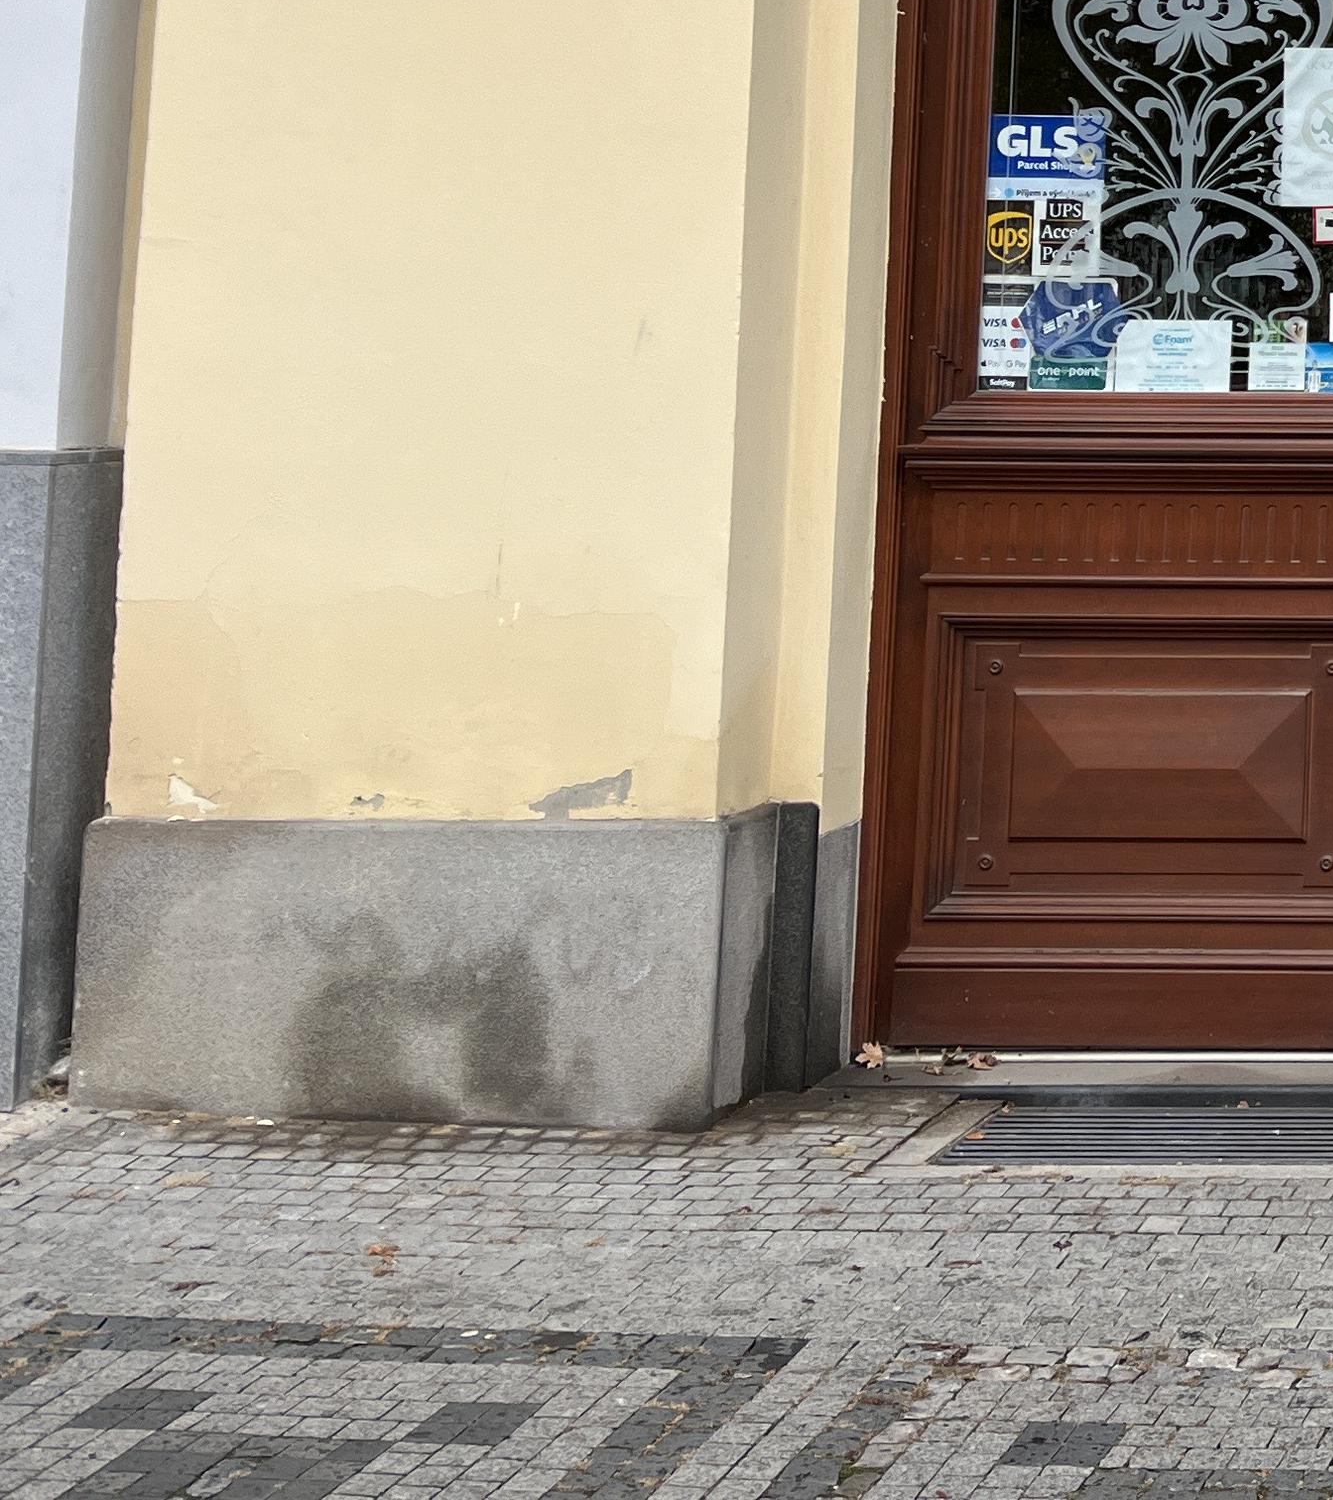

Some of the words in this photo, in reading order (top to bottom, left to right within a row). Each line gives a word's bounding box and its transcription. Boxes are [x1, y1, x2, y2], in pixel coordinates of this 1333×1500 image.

[997, 125, 1079, 158] GLS
[1018, 161, 1048, 170] Parcel
[1049, 203, 1081, 217] UPS
[991, 227, 1028, 254] ups
[984, 319, 1007, 328] VISA
[983, 338, 1006, 347] VISA
[1069, 366, 1099, 377] point
